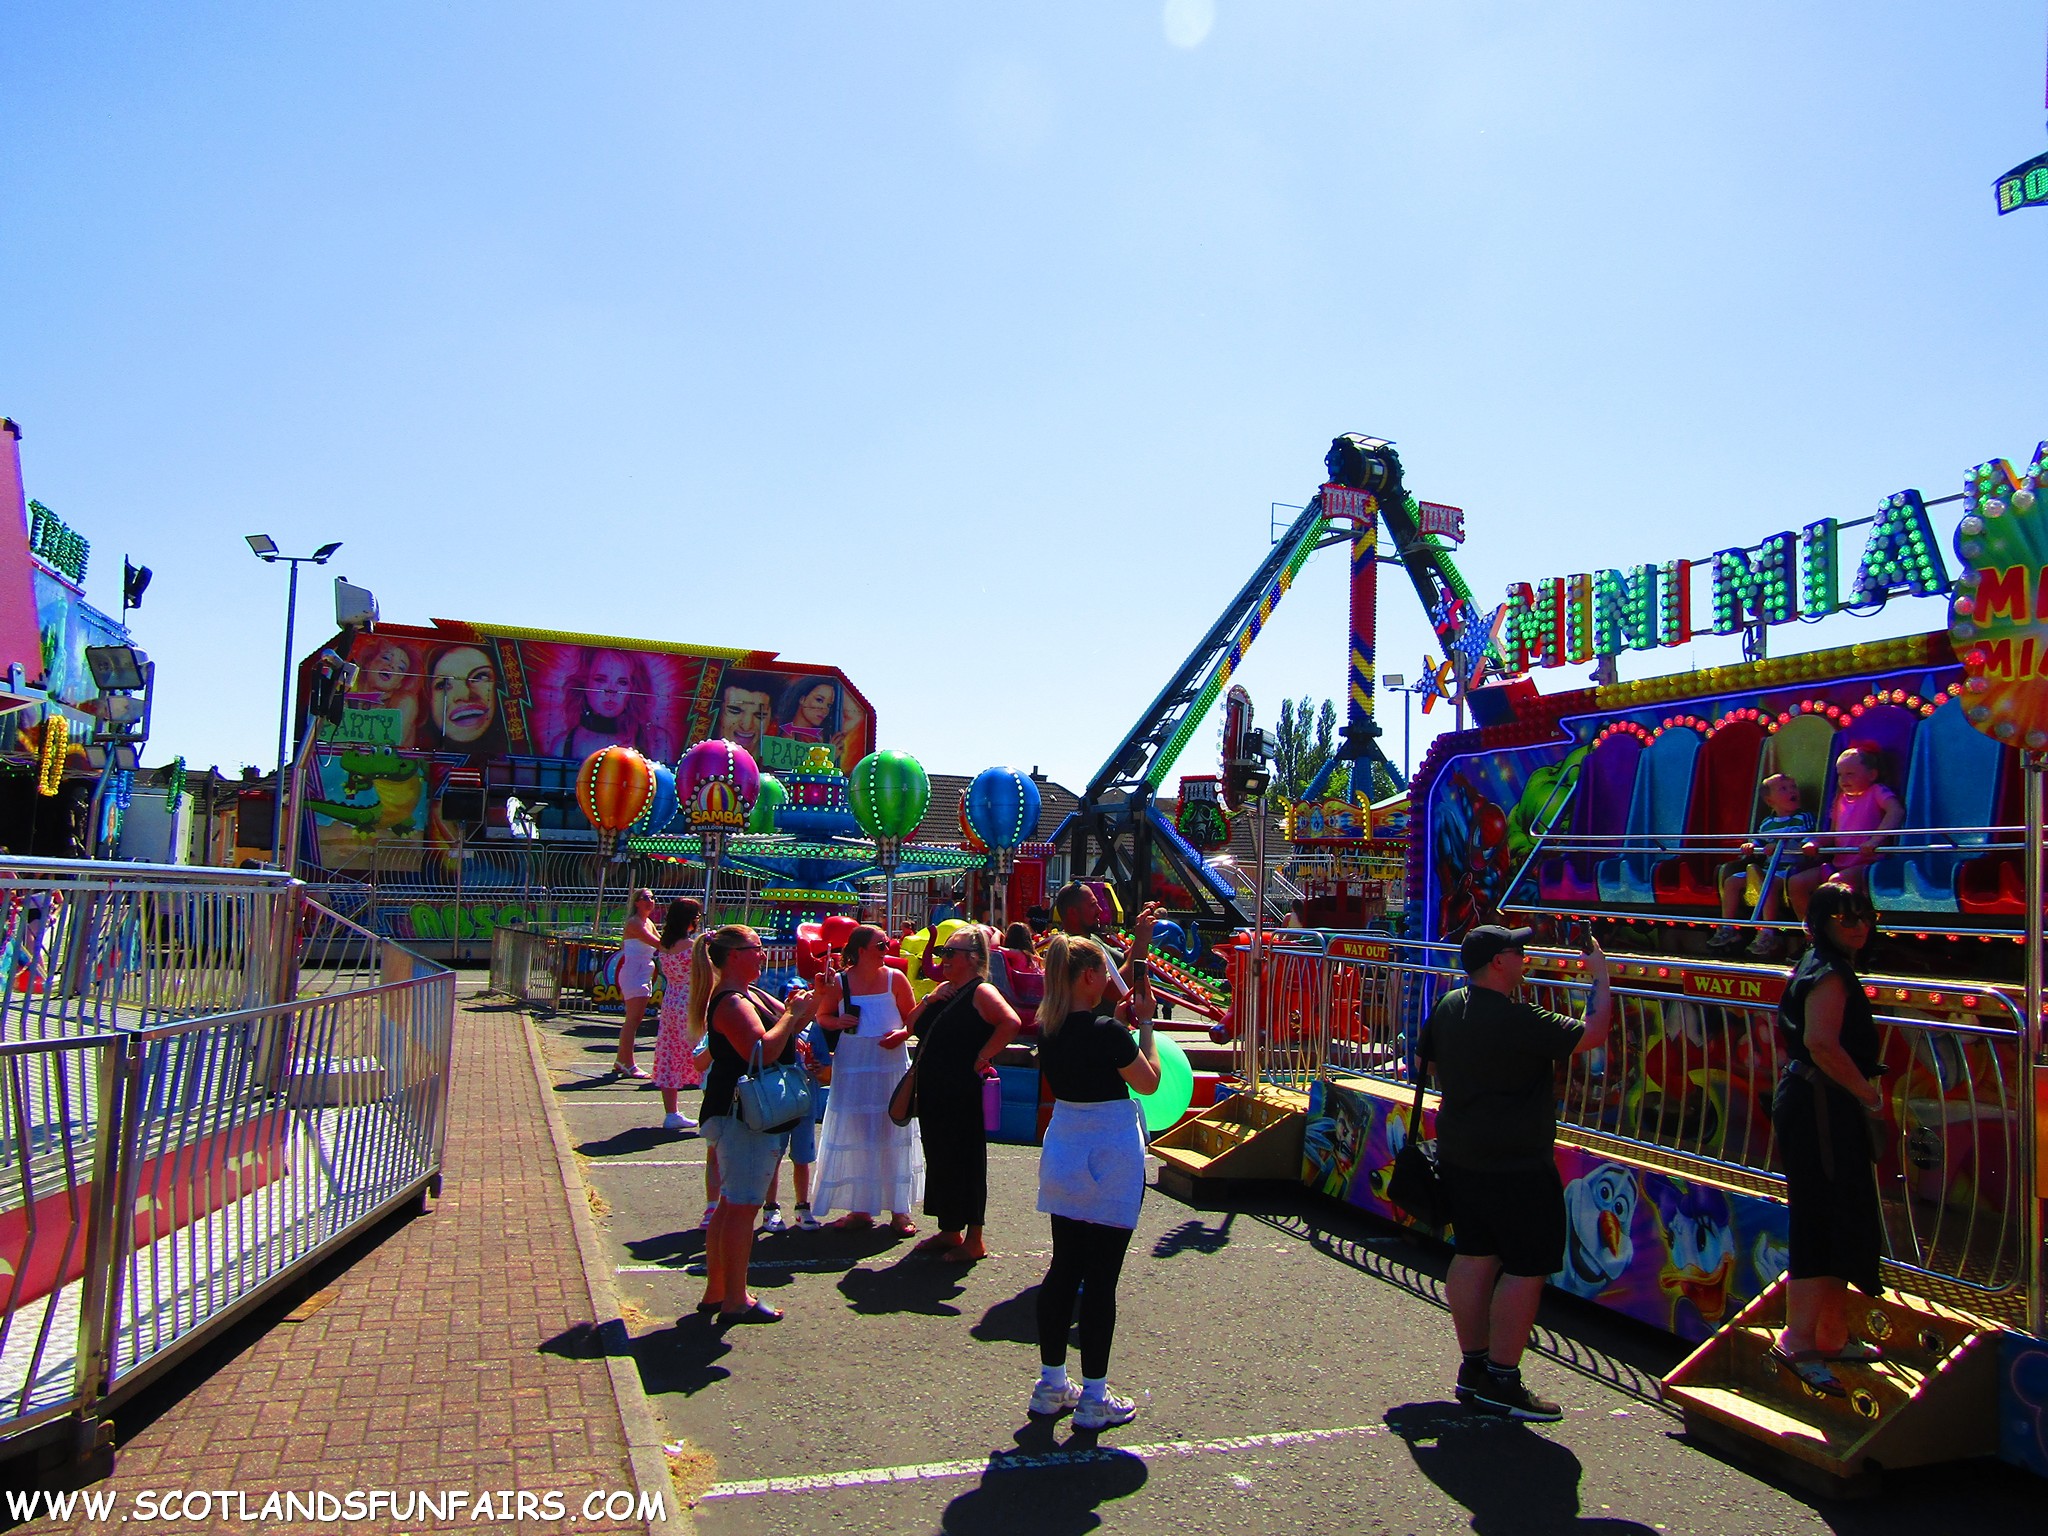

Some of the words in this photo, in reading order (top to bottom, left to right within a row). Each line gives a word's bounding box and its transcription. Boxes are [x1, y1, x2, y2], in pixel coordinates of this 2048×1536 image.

[1505, 558, 1691, 673] MINI
[771, 740, 810, 766] PAR
[691, 810, 744, 826] SAMBA
[1343, 943, 1365, 956] WAY
[1366, 945, 1387, 958] OUT
[592, 984, 664, 1005] SAA
[1694, 976, 1735, 995] WAY
[1740, 980, 1762, 997] IN
